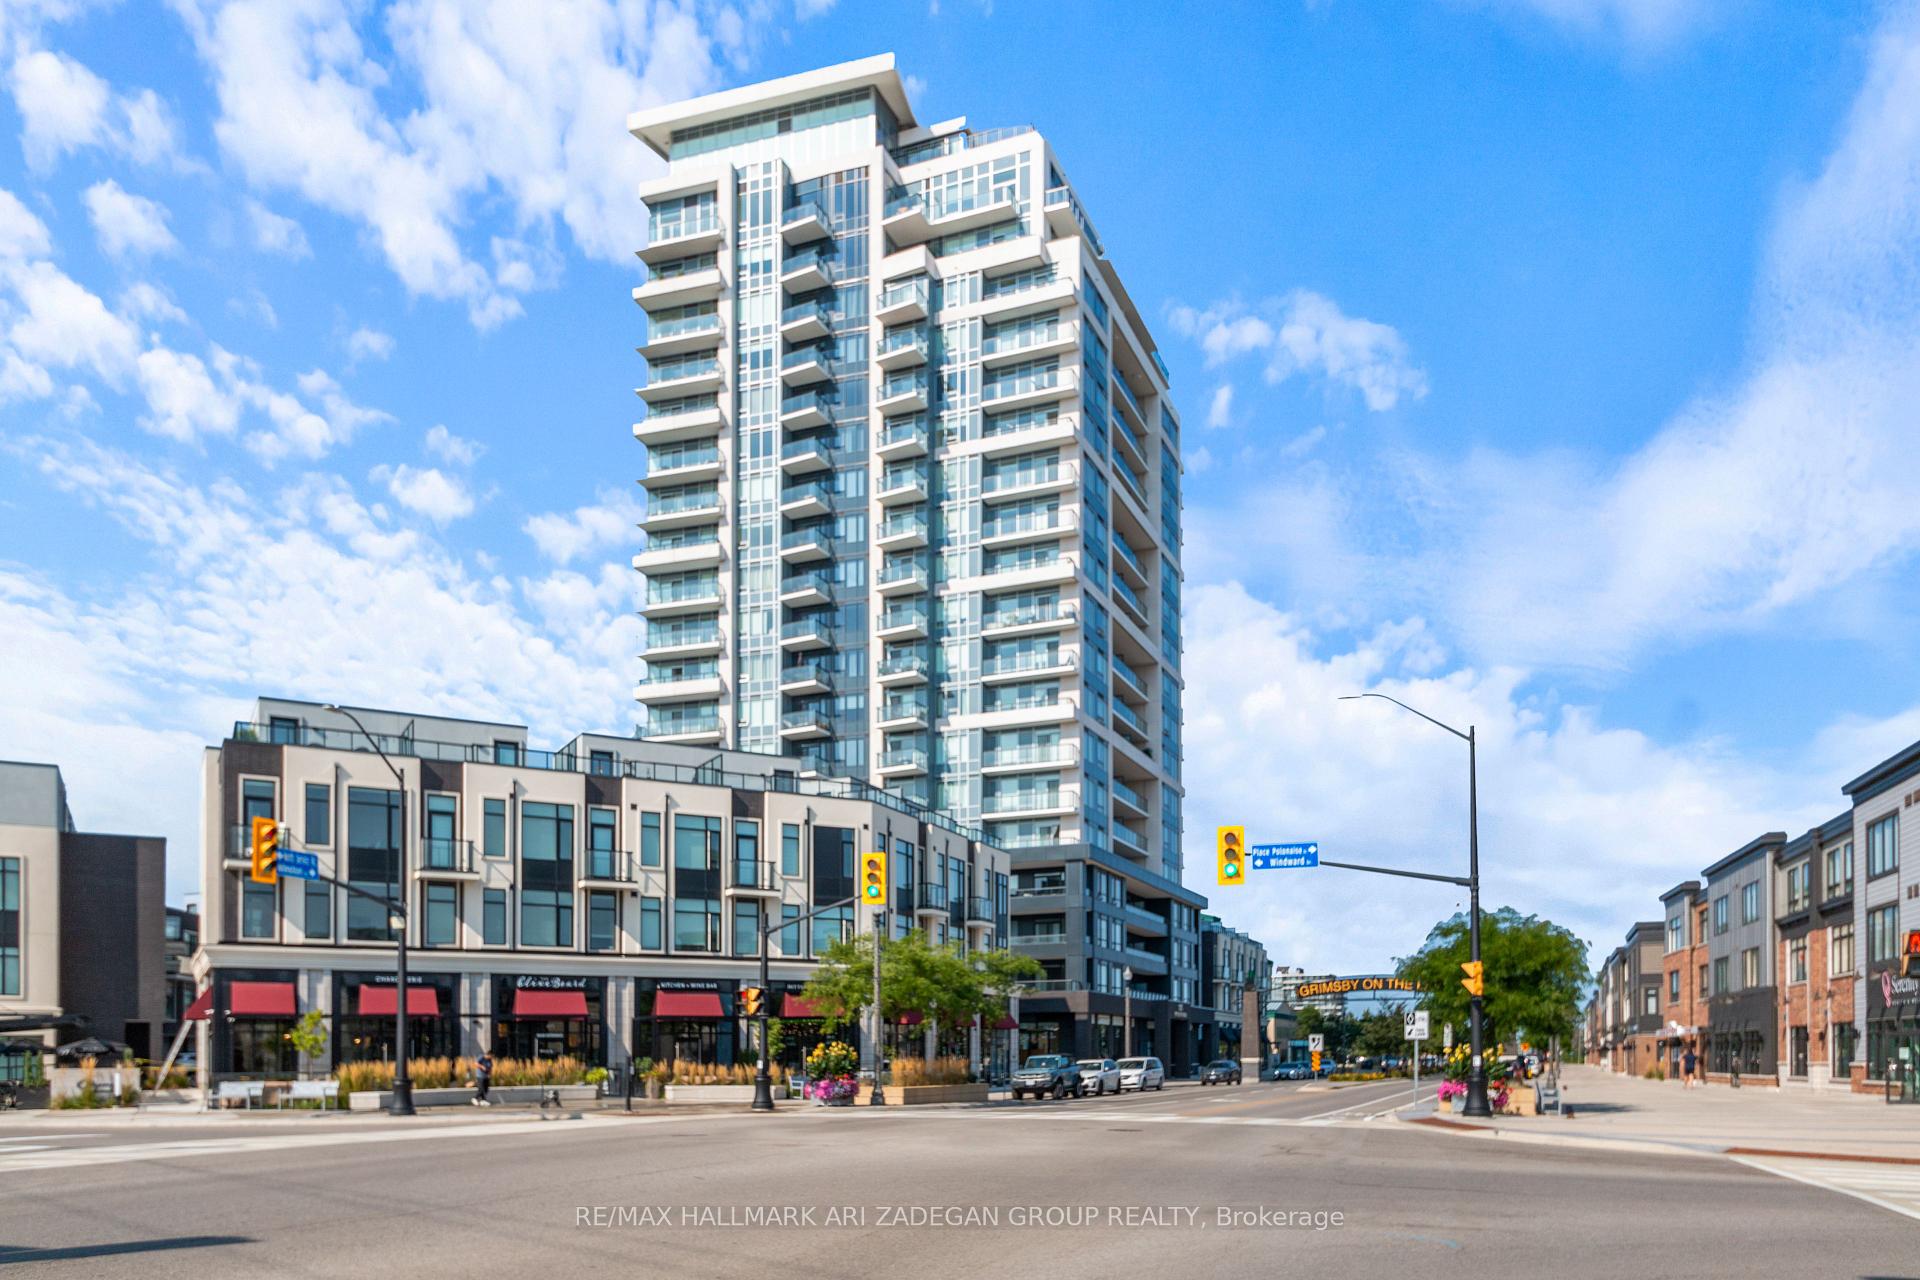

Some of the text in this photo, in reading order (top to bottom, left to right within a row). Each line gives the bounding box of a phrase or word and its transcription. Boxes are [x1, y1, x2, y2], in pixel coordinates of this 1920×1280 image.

[1253, 848, 1270, 857] Place
[1272, 846, 1303, 856] Polonaise
[1270, 857, 1305, 867] Windward
[660, 981, 686, 989] KITCHEN
[1299, 978, 1359, 998] GRIMSBY
[1362, 978, 1384, 991] ON
[1387, 978, 1413, 991] THE
